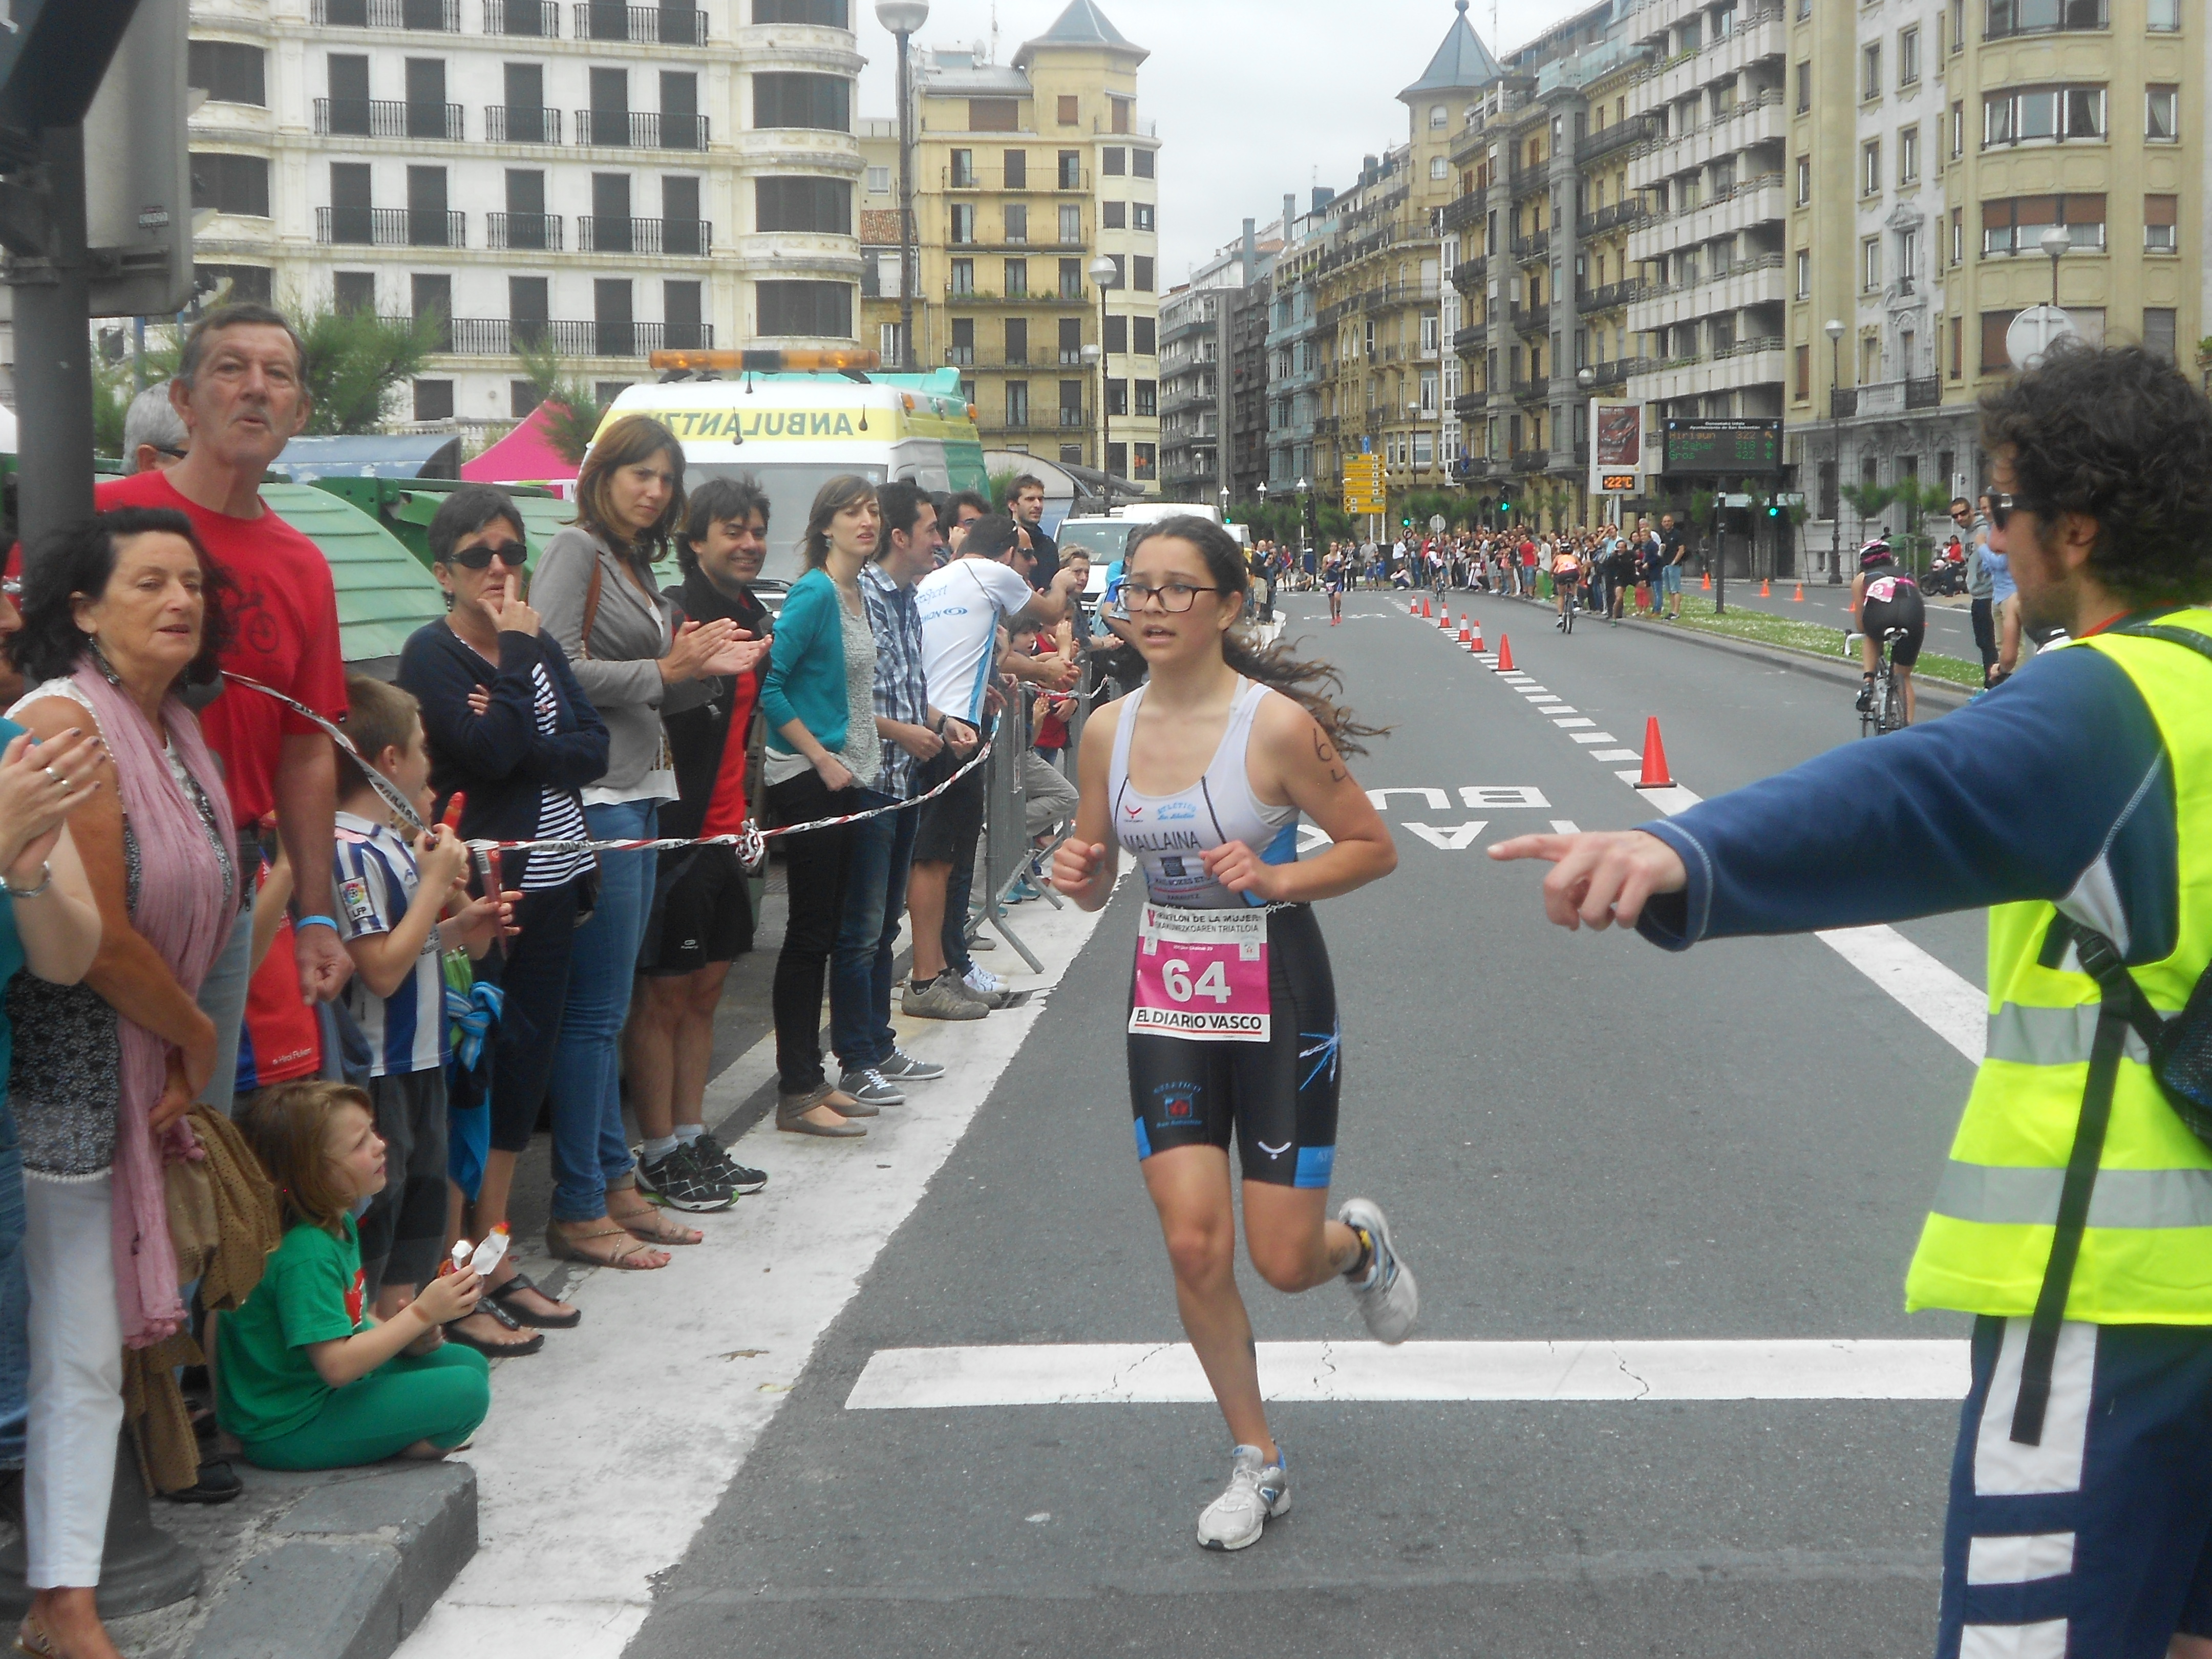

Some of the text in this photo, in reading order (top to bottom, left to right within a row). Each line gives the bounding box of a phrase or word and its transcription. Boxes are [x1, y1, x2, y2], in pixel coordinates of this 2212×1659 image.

[1669, 451, 1756, 459] Gros 422
[352, 906, 367, 917] LFP
[1218, 923, 1259, 933] TRIATLOIA
[1162, 959, 1231, 1004] 64
[1136, 1009, 1262, 1030] EL DIARIO VASCO
